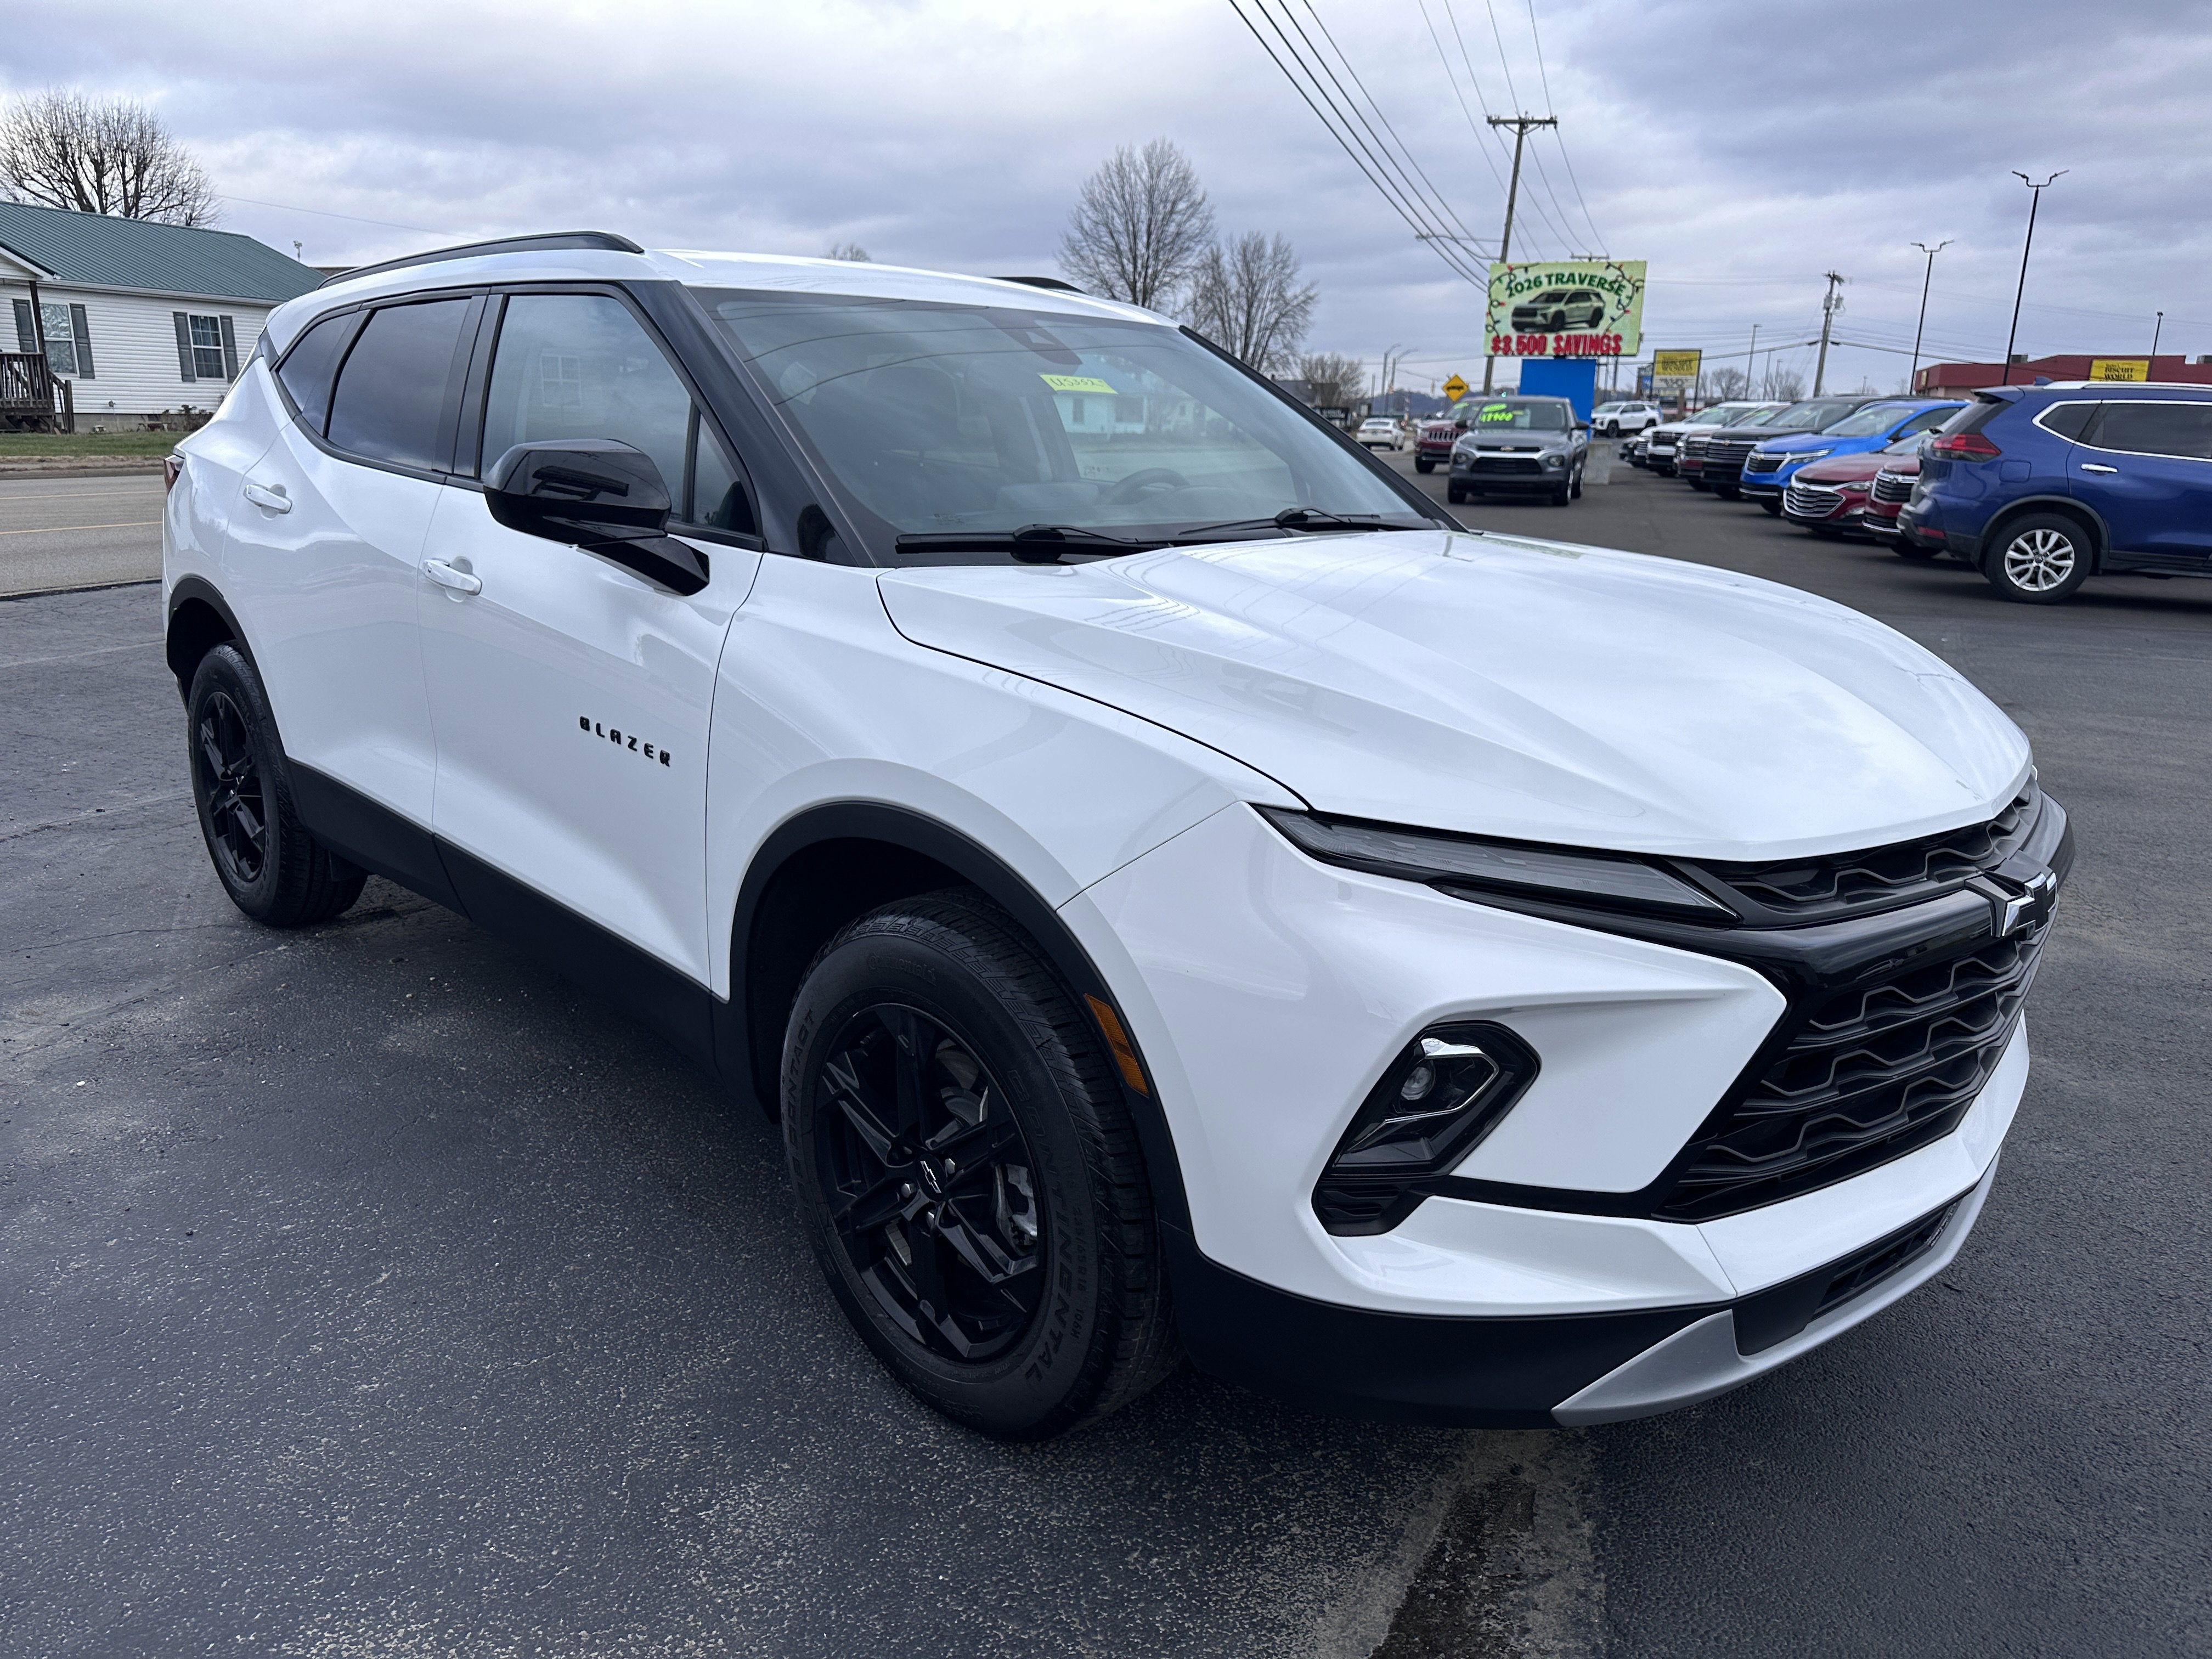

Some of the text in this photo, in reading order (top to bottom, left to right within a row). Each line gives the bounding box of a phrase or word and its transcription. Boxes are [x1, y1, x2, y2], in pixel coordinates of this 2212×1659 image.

[1505, 273, 1626, 298] 2026 TRAVERSE
[1491, 334, 1622, 356] $3,500 SAVINGS
[579, 715, 670, 768] BLAZER
